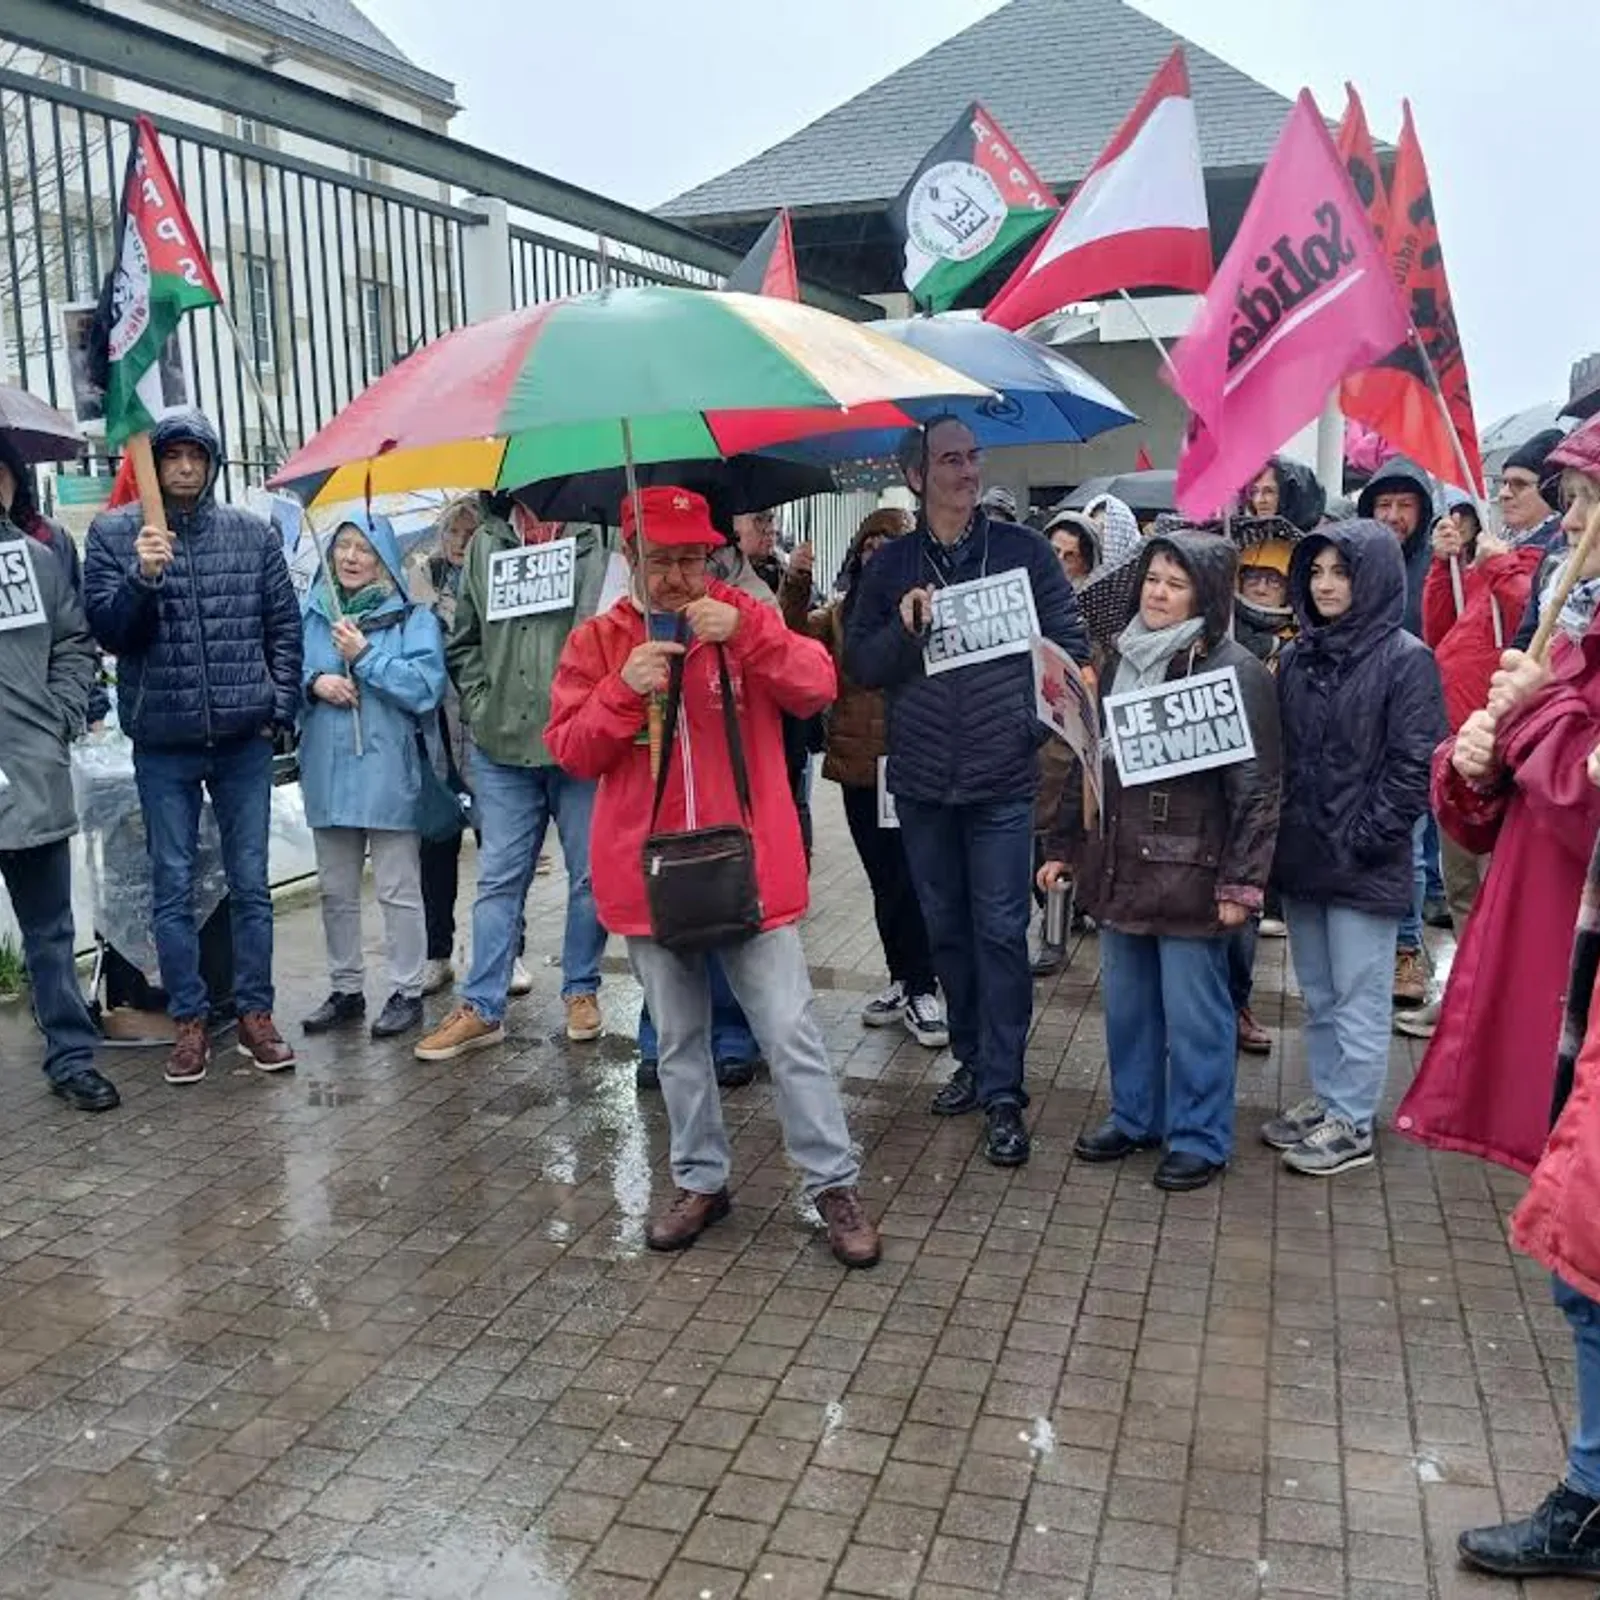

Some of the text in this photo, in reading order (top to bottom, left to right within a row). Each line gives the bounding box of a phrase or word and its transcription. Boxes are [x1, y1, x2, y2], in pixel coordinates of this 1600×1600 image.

[494, 548, 570, 585] JE SUIS
[492, 574, 569, 609] ERWAN
[963, 580, 1025, 621] SUIS
[928, 608, 1031, 663] ERWAN
[1117, 701, 1157, 739] JE
[1163, 681, 1236, 728] SUIS
[1121, 714, 1245, 771] ERWAN
